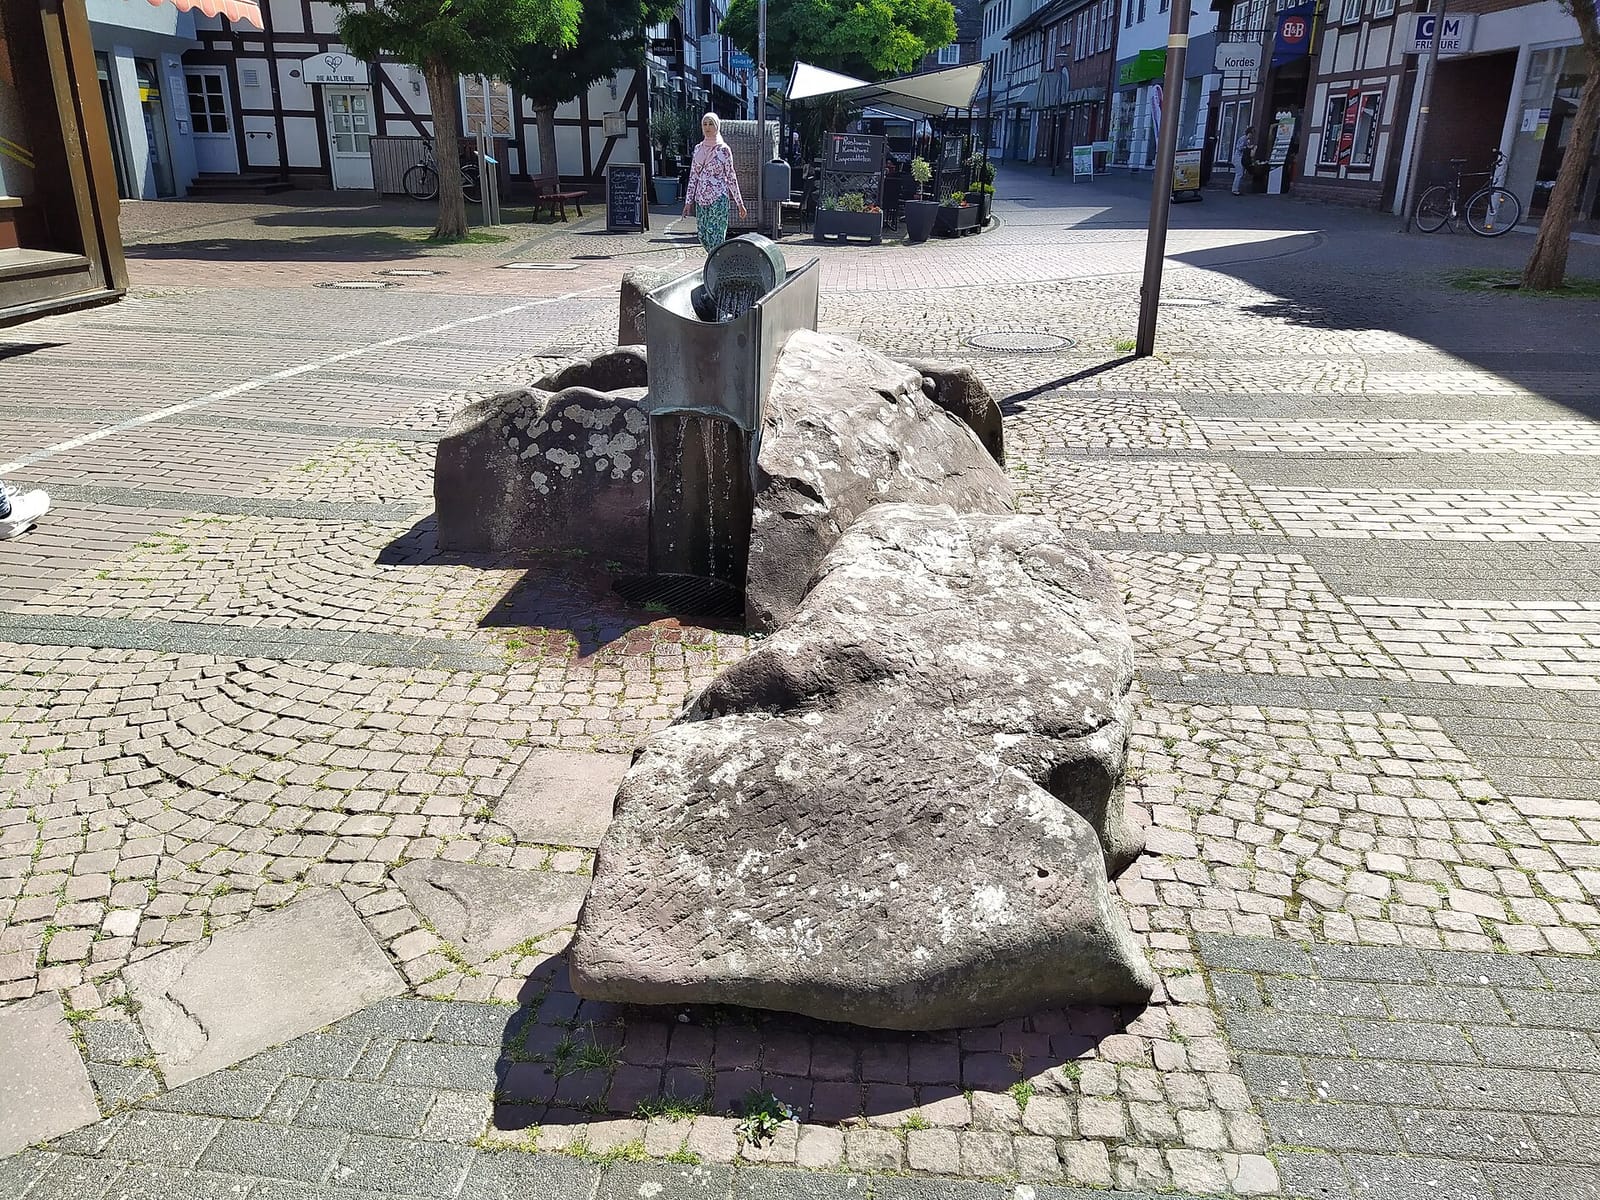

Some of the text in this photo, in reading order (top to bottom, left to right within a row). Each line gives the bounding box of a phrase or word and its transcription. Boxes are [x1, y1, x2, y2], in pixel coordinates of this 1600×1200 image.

[1283, 22, 1305, 38] B&B
[1415, 40, 1460, 49] FRISURE
[1224, 57, 1255, 67] Kordes
